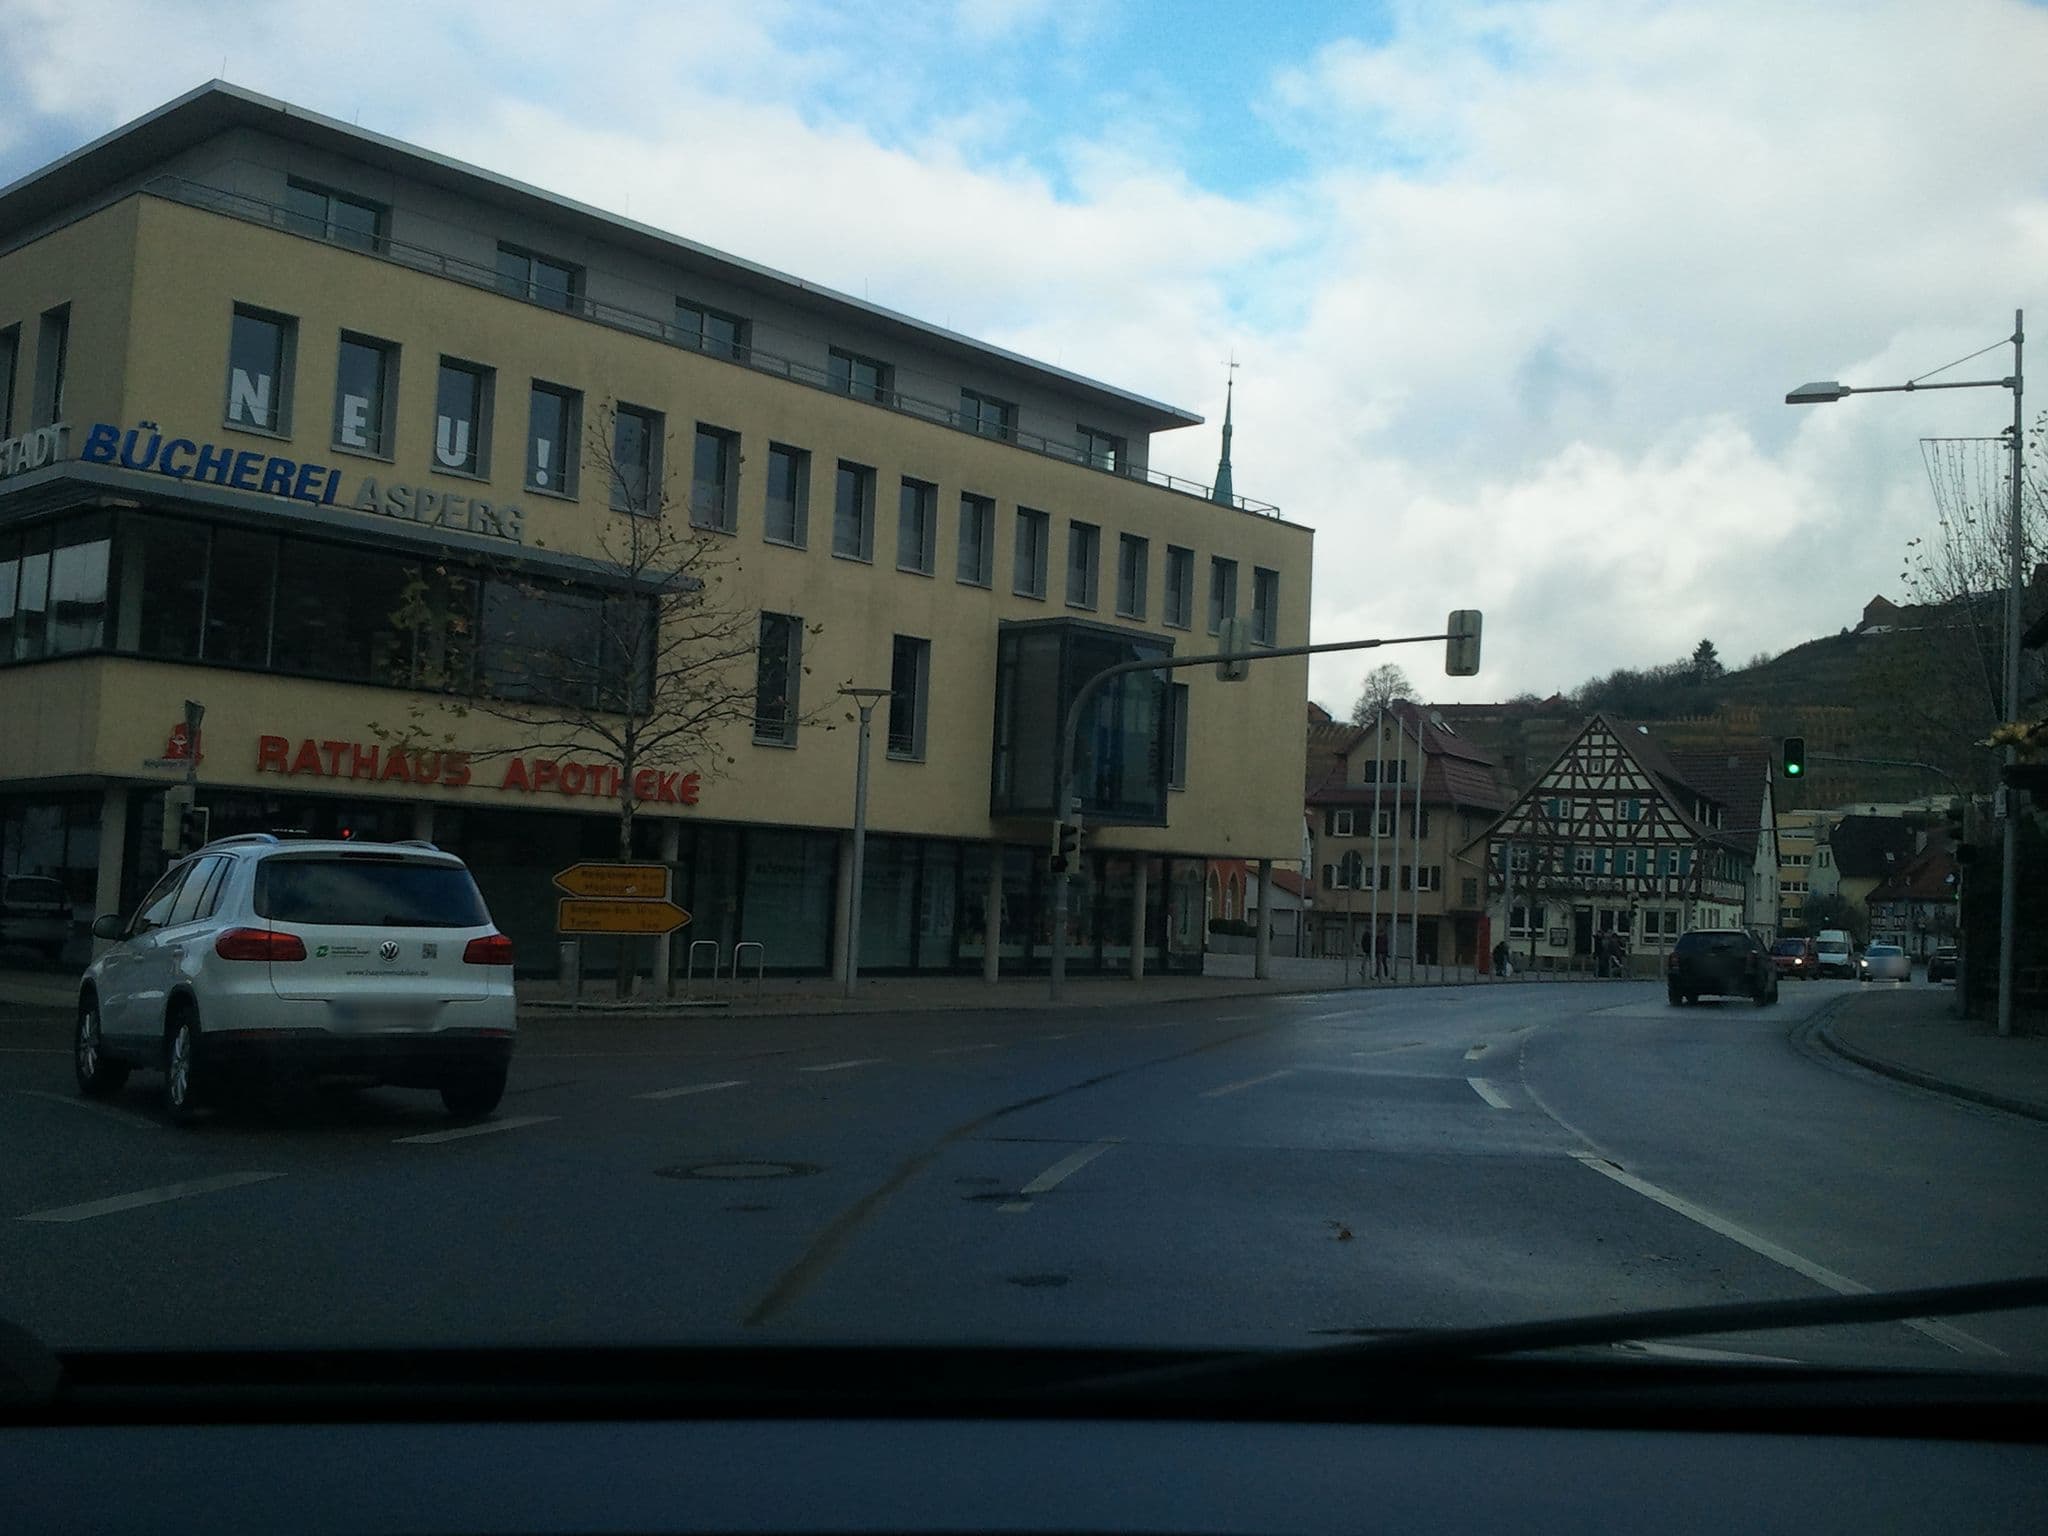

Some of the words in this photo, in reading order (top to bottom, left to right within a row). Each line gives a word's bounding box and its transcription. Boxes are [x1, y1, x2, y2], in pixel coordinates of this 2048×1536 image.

[84, 420, 340, 504] BÜCHEREI
[357, 476, 526, 541] ASPERG
[256, 734, 473, 788] RATHAUS
[502, 756, 702, 807] APOTHEKE
